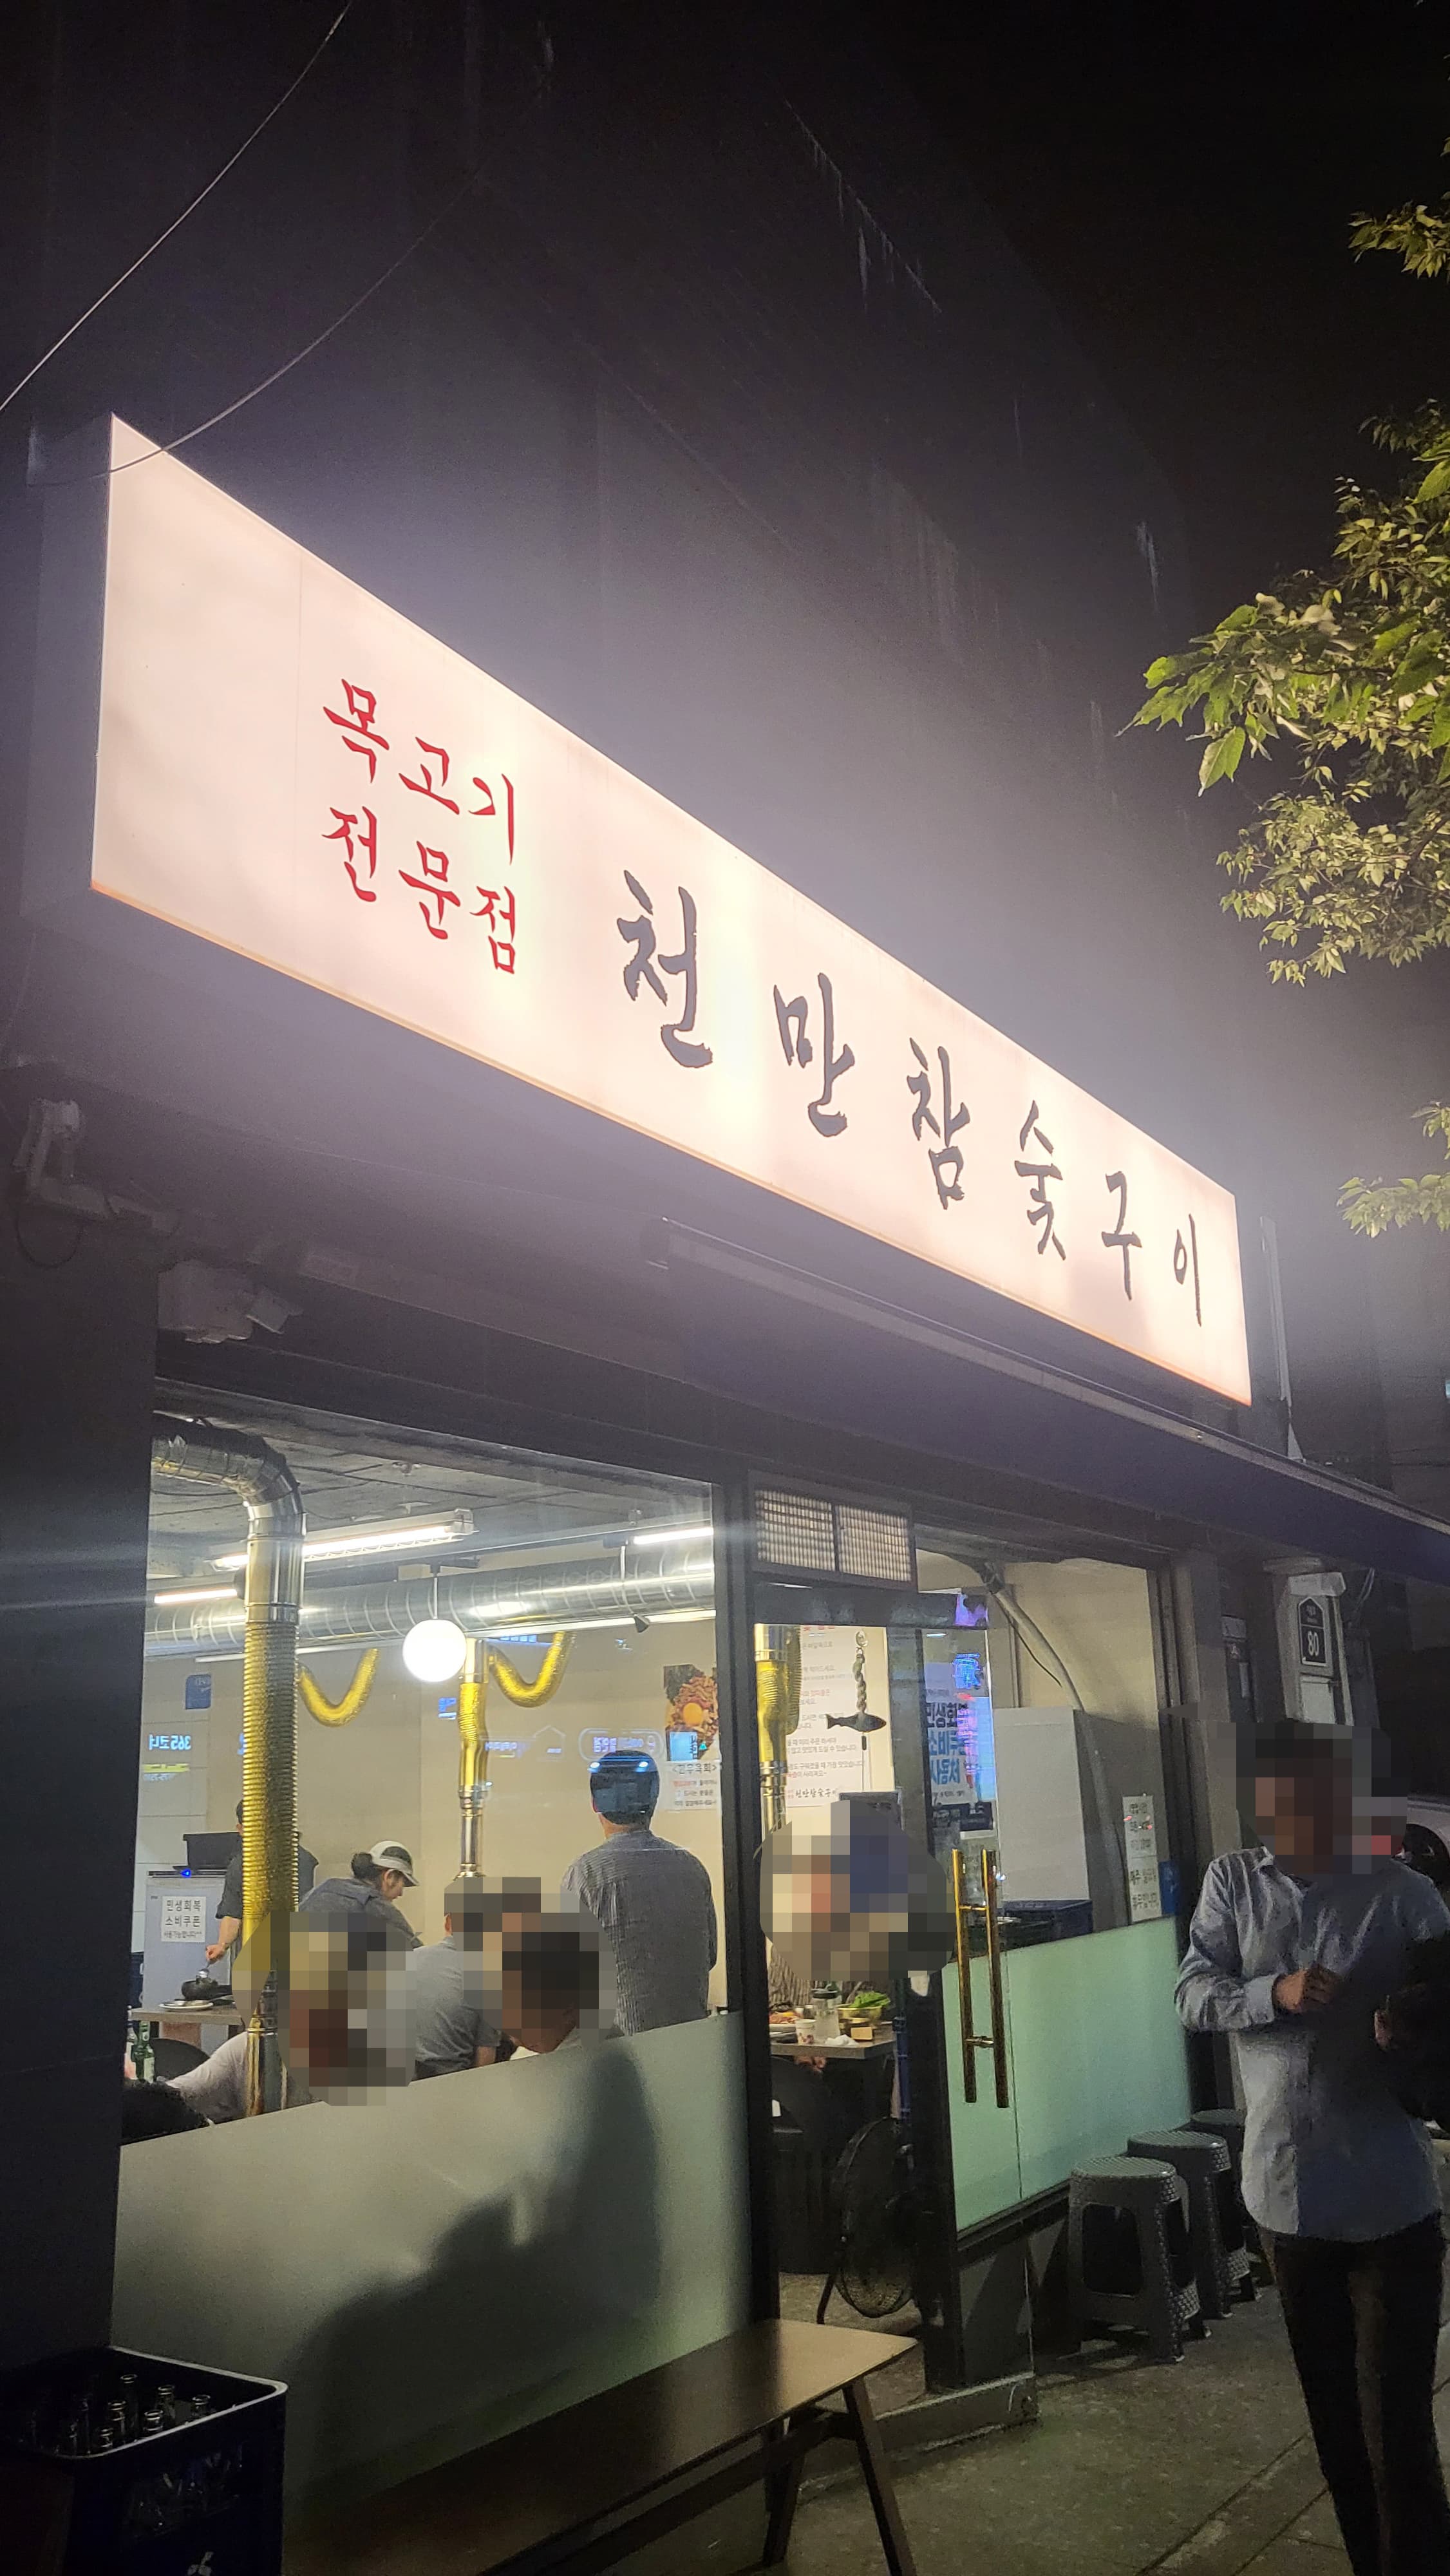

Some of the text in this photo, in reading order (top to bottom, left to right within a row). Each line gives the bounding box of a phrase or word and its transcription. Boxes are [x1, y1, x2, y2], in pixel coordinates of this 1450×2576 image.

[323, 678, 514, 866] 목고기
[322, 806, 515, 974] 전문점
[616, 869, 1202, 1327] 천만참숯구이
[1308, 1631, 1319, 1656] 80
[930, 1758, 960, 1785] 사용처
[167, 1900, 201, 1911] 민생회복
[165, 1915, 200, 1927] 소비쿠폰
